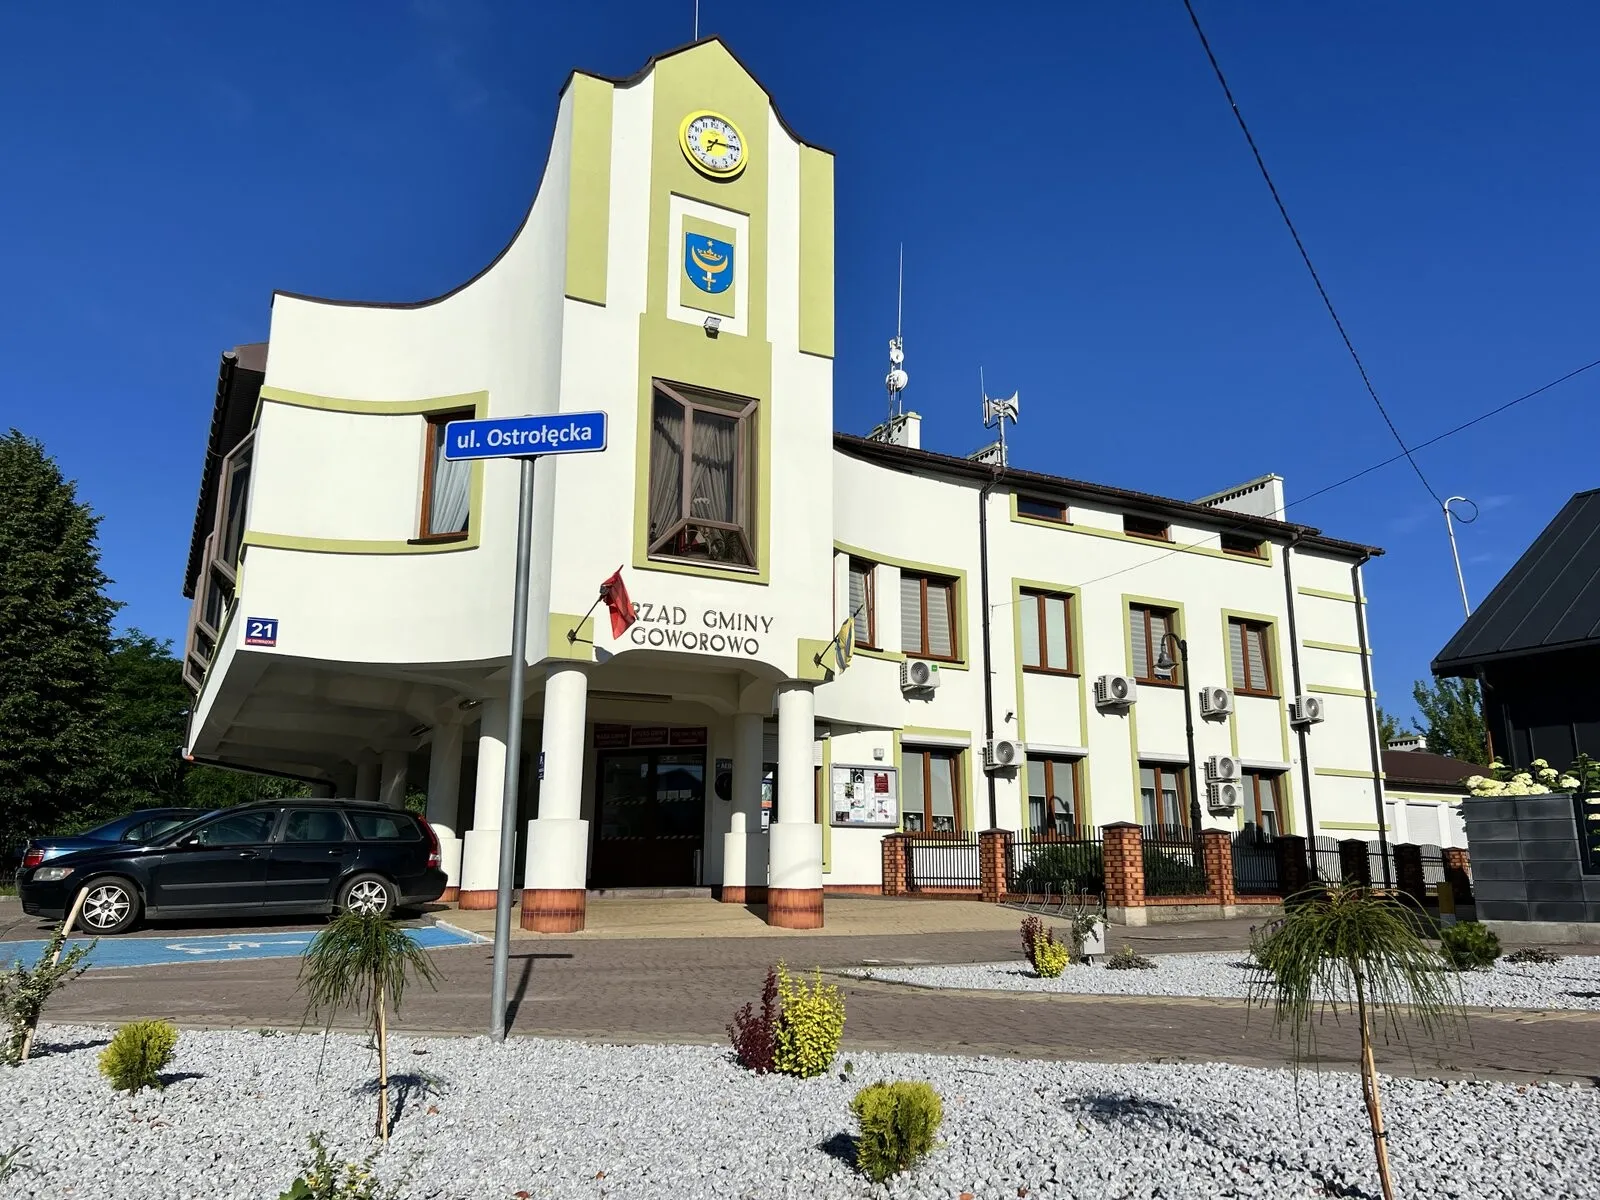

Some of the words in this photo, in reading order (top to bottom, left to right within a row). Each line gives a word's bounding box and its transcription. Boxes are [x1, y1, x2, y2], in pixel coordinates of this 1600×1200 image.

[457, 430, 481, 449] ul.
[487, 423, 592, 447] Ostrołęcka
[250, 622, 273, 638] 21
[702, 609, 774, 634] GMINY
[630, 626, 760, 656] GOWOROWO
